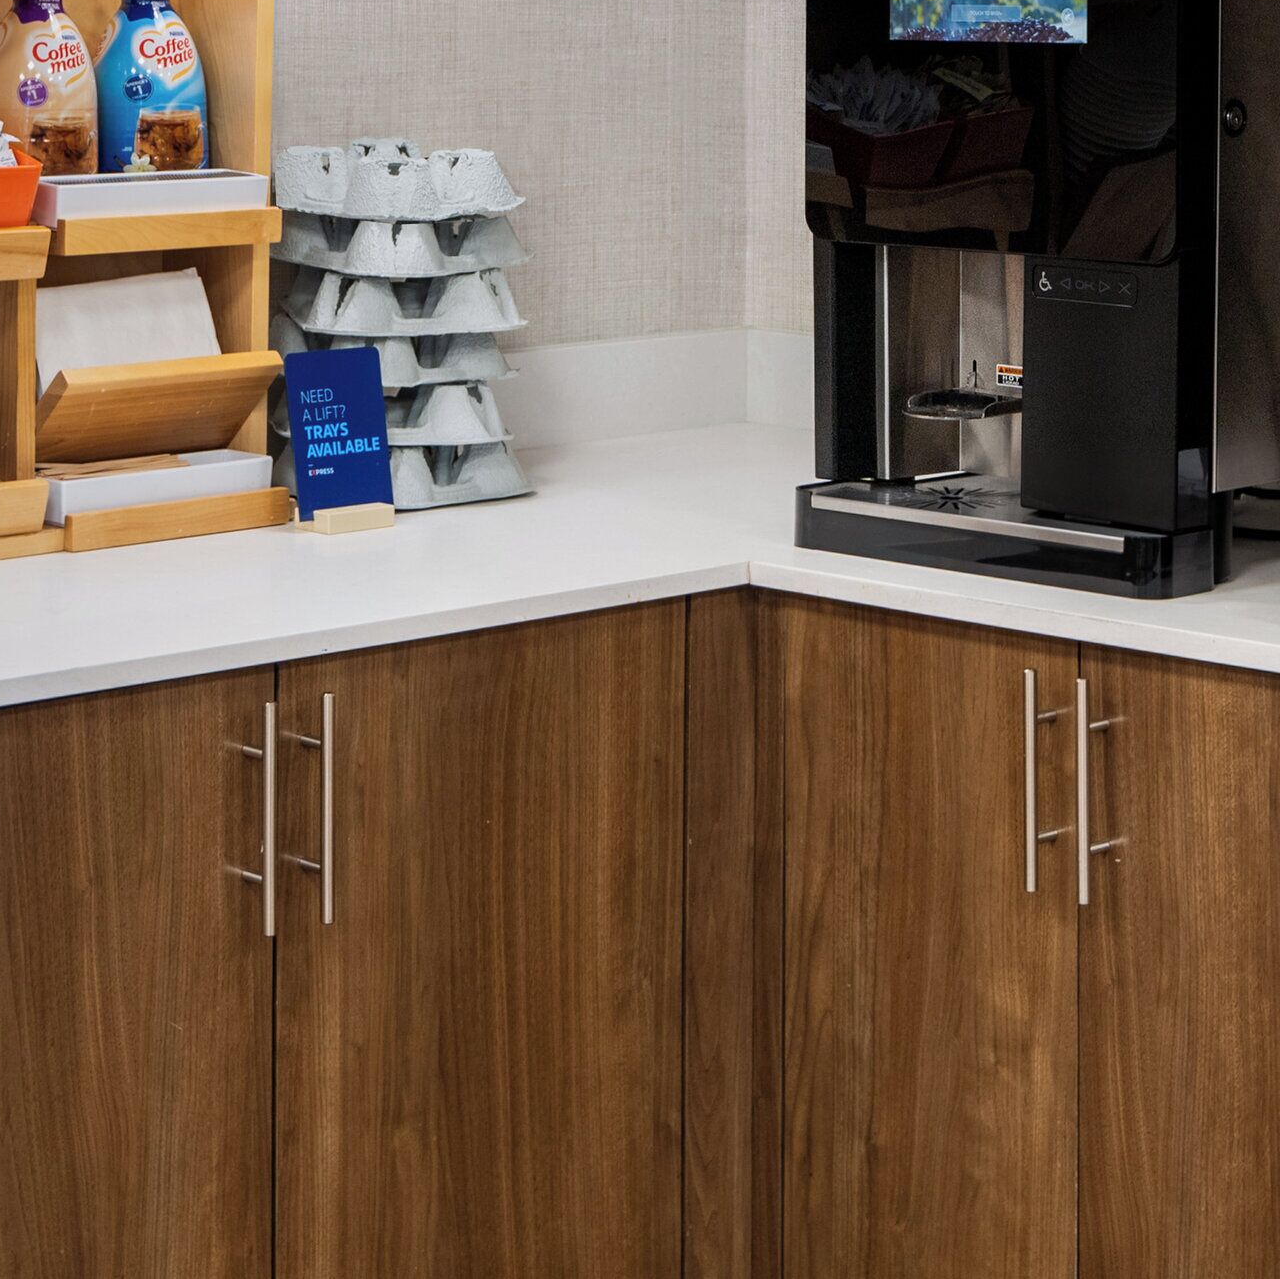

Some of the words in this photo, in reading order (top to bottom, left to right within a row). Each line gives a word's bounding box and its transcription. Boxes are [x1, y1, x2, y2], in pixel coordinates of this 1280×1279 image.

[32, 41, 82, 64] Coffee
[138, 37, 190, 59] Coffee
[156, 48, 194, 69] mate
[50, 53, 86, 74] mate
[300, 388, 334, 404] NEED
[302, 409, 312, 423] A
[314, 405, 346, 421] LIFT?
[304, 422, 349, 440] TRAYS
[306, 437, 381, 459] AVAILABLE
[308, 467, 335, 477] EXPRESS
